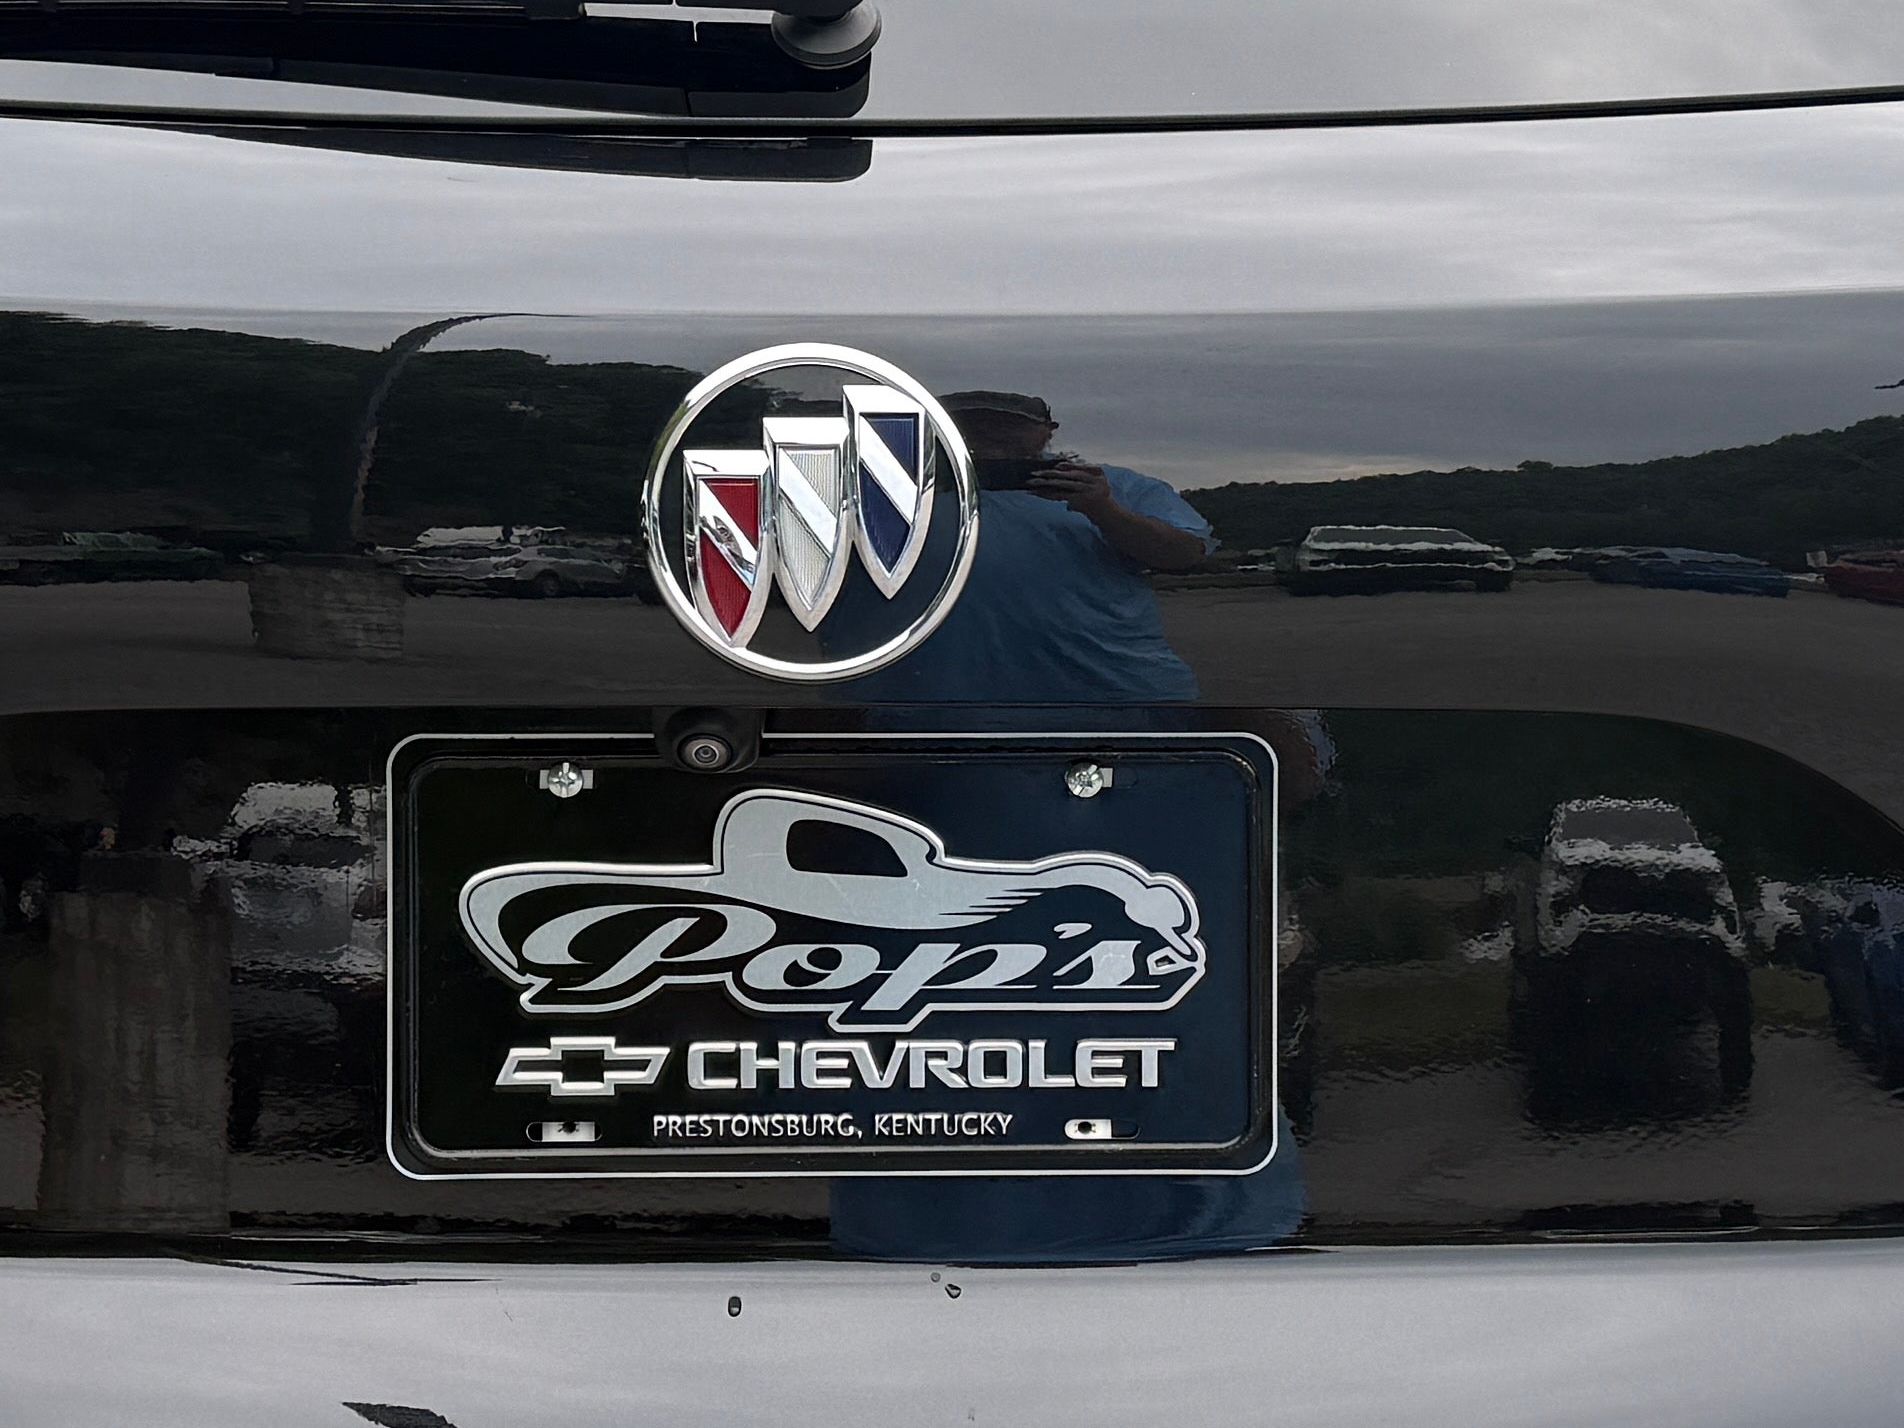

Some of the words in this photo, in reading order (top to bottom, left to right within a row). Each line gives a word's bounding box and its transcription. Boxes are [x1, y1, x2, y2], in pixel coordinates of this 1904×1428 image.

[521, 903, 1161, 1011] Pop's
[687, 1038, 1177, 1091] CHEVROLET
[652, 1112, 864, 1141] PRESTONSBURG,
[874, 1112, 1014, 1139] KENTUCKY
